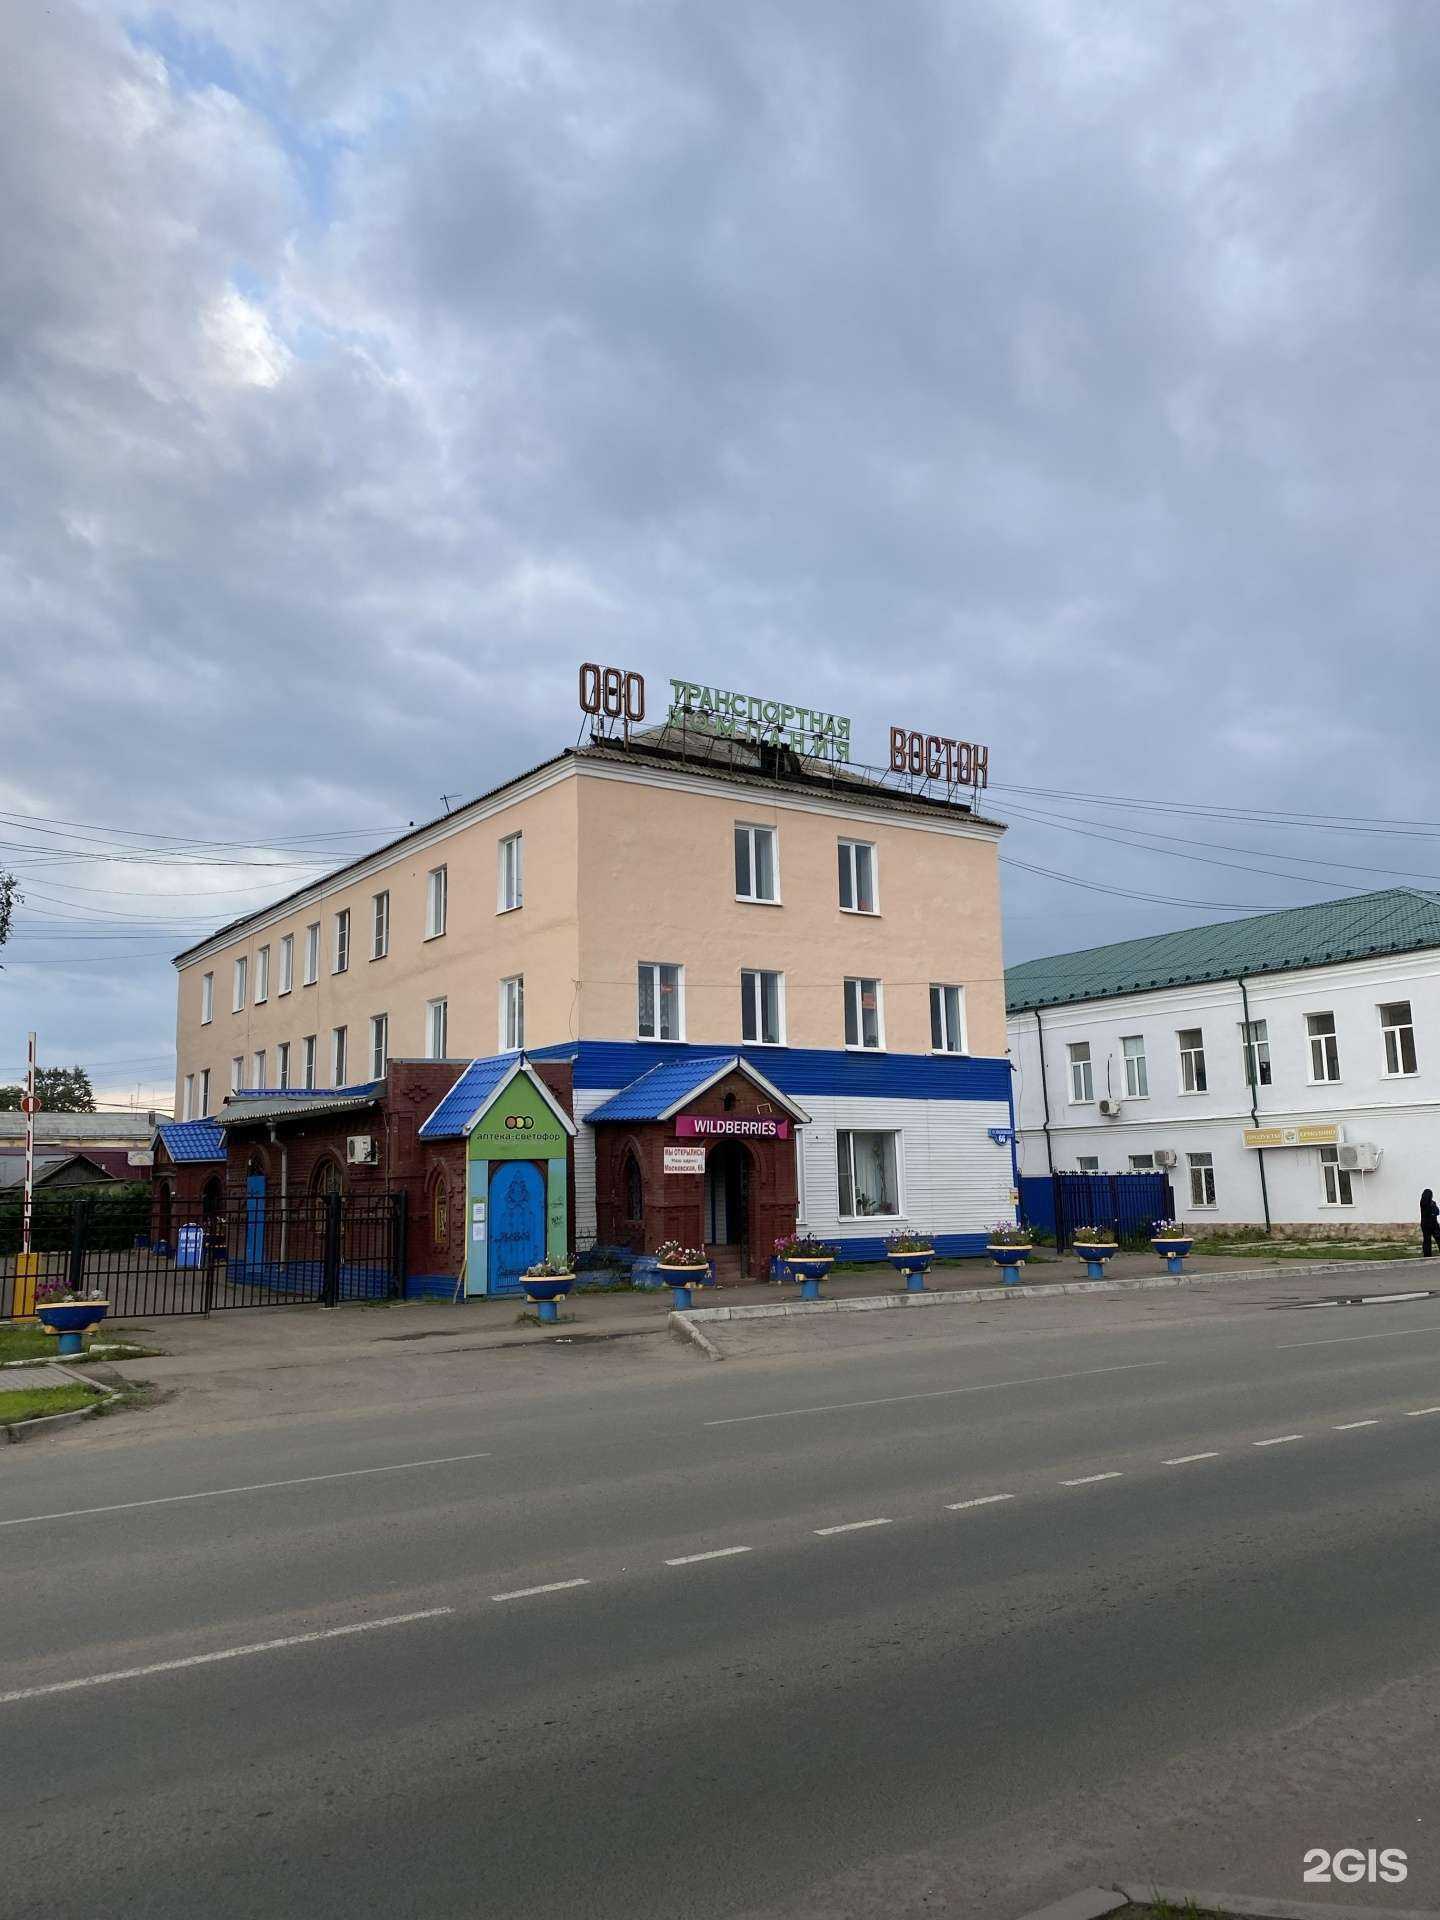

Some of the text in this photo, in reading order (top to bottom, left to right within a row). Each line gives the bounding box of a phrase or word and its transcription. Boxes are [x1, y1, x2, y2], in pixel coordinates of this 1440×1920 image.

[668, 705, 850, 762] КОМПАНИЯ
[670, 679, 850, 740] ТРАНСПОРТНАЯ
[891, 727, 988, 788] ВОСТОК
[477, 1132, 560, 1142] аптека-светофор
[694, 1119, 777, 1135] WILDBERRIES
